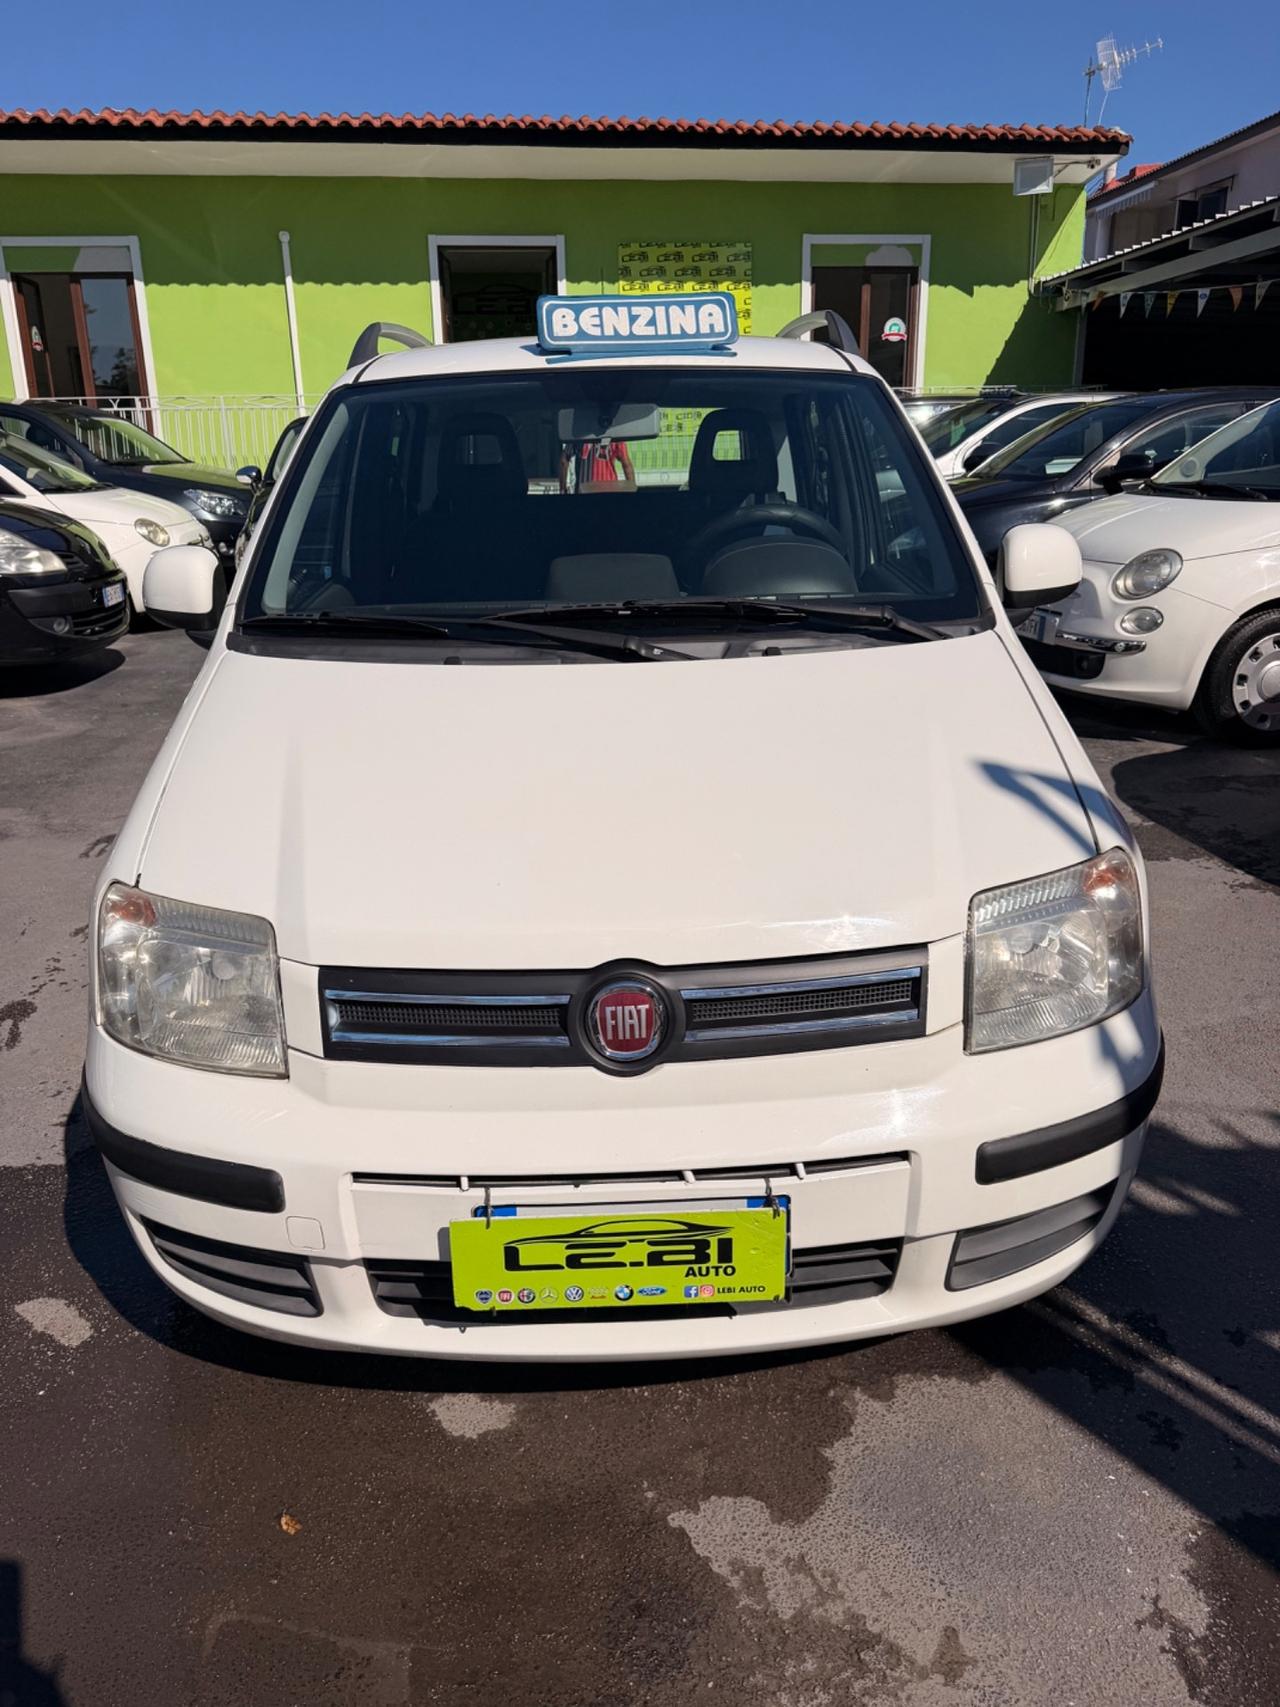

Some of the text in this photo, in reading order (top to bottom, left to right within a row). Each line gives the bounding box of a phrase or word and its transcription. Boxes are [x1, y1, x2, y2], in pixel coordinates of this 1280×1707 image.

[551, 302, 726, 338] BENZINA
[604, 1003, 650, 1041] FIAT
[684, 1264, 736, 1278] AUTO
[717, 1285, 766, 1294] LEBI AUTO
